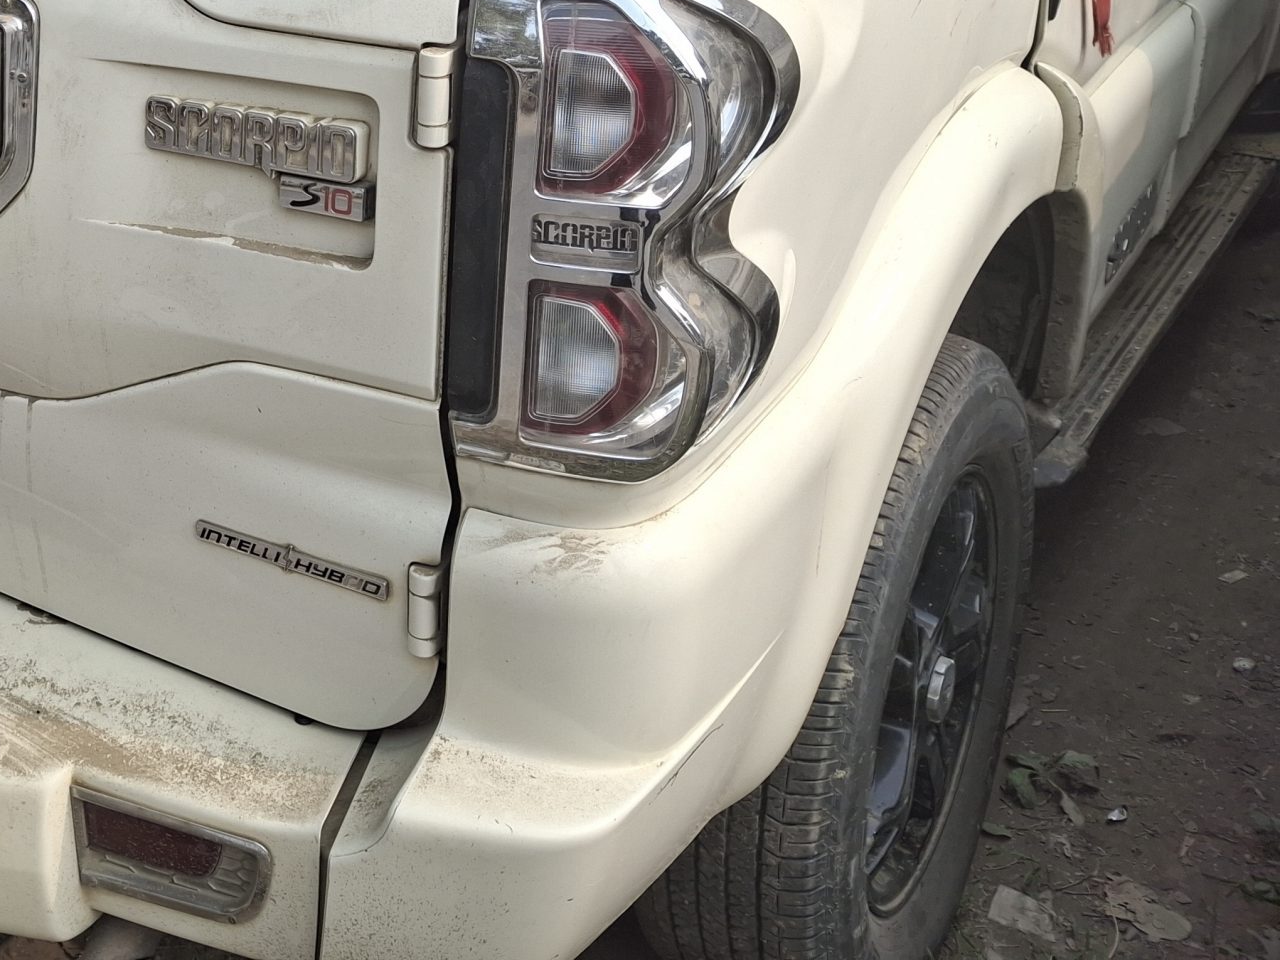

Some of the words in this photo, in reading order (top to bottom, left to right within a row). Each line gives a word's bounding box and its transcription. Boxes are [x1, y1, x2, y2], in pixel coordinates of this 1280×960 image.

[144, 95, 366, 184] SCORPIO
[288, 181, 354, 216] S10
[532, 219, 639, 253] SCORPIO
